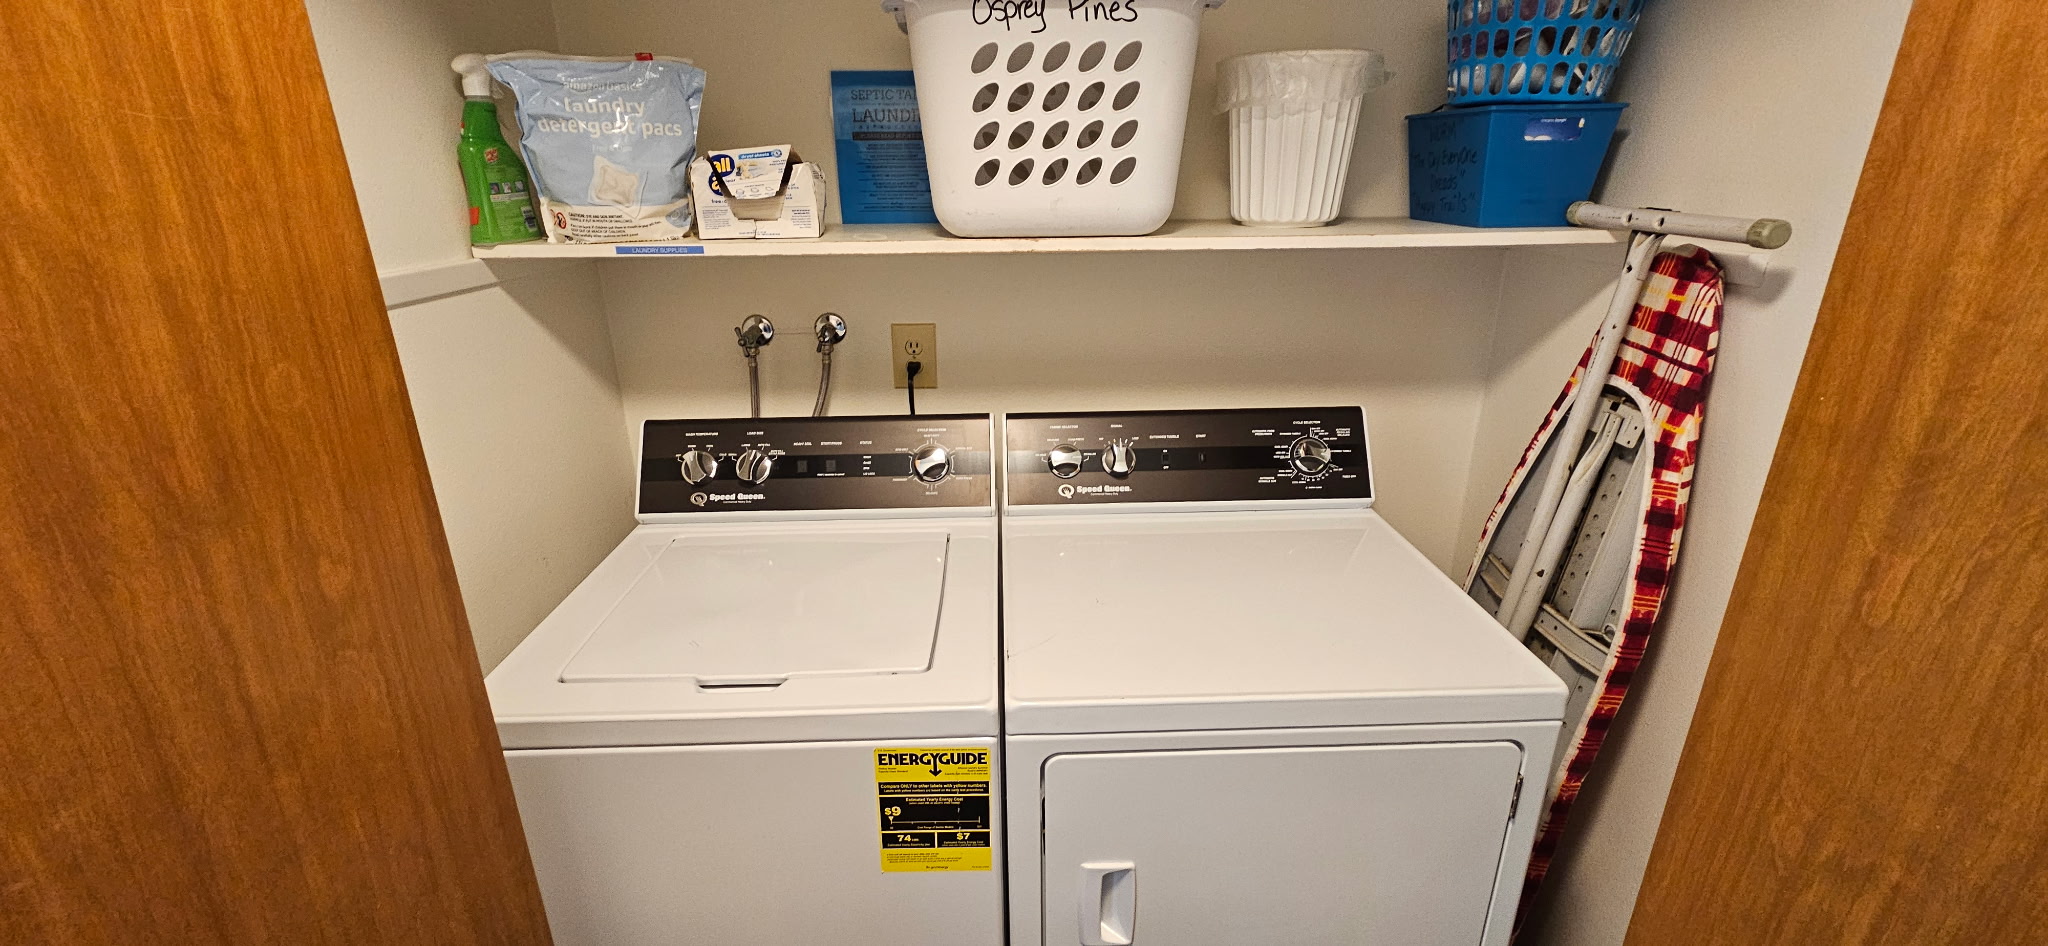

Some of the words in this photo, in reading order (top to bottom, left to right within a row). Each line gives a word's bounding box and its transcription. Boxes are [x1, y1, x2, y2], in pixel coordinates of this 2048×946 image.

[972, 0, 1046, 34] Osprey
[1069, 0, 1138, 22] Pines
[851, 89, 893, 100] SEPTIC
[563, 97, 645, 117] laundry
[538, 116, 636, 138] detergent
[641, 120, 683, 139] pacs
[1076, 485, 1102, 494] Speed
[709, 493, 736, 502] Speed
[878, 752, 987, 769] ENERGYGUIDE
[884, 806, 901, 816] $9
